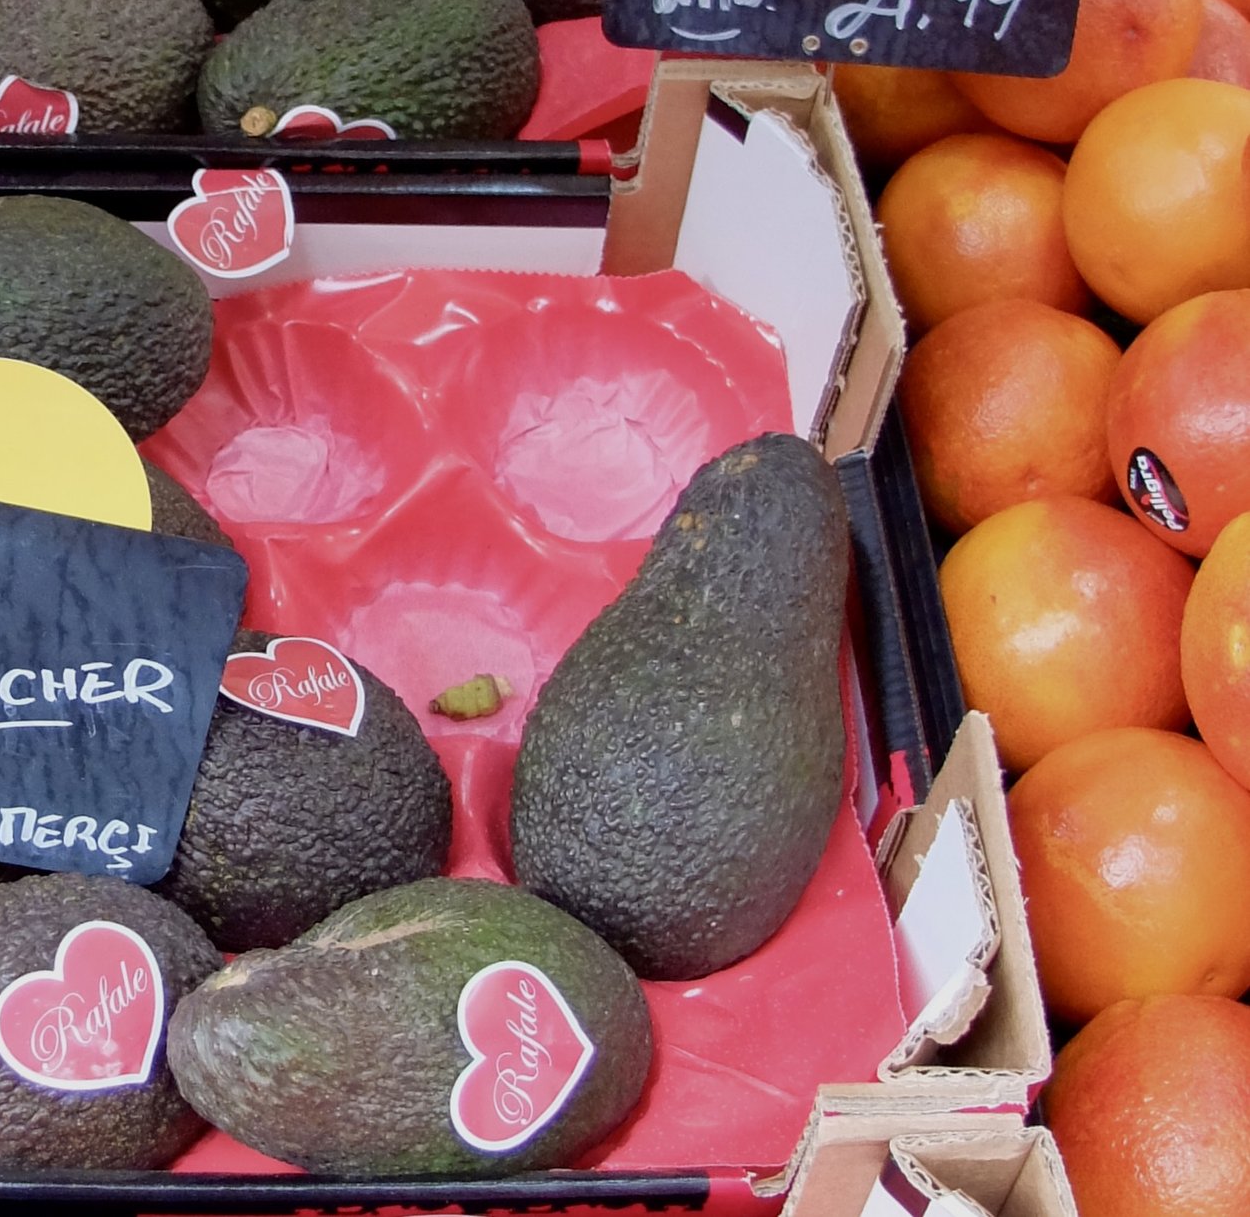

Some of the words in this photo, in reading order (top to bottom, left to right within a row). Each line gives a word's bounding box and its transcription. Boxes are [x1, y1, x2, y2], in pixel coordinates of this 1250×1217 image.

[200, 172, 271, 269] Rafale
[248, 661, 350, 709] Rafale
[30, 960, 147, 1073] Rafale
[493, 978, 553, 1126] Rafale
